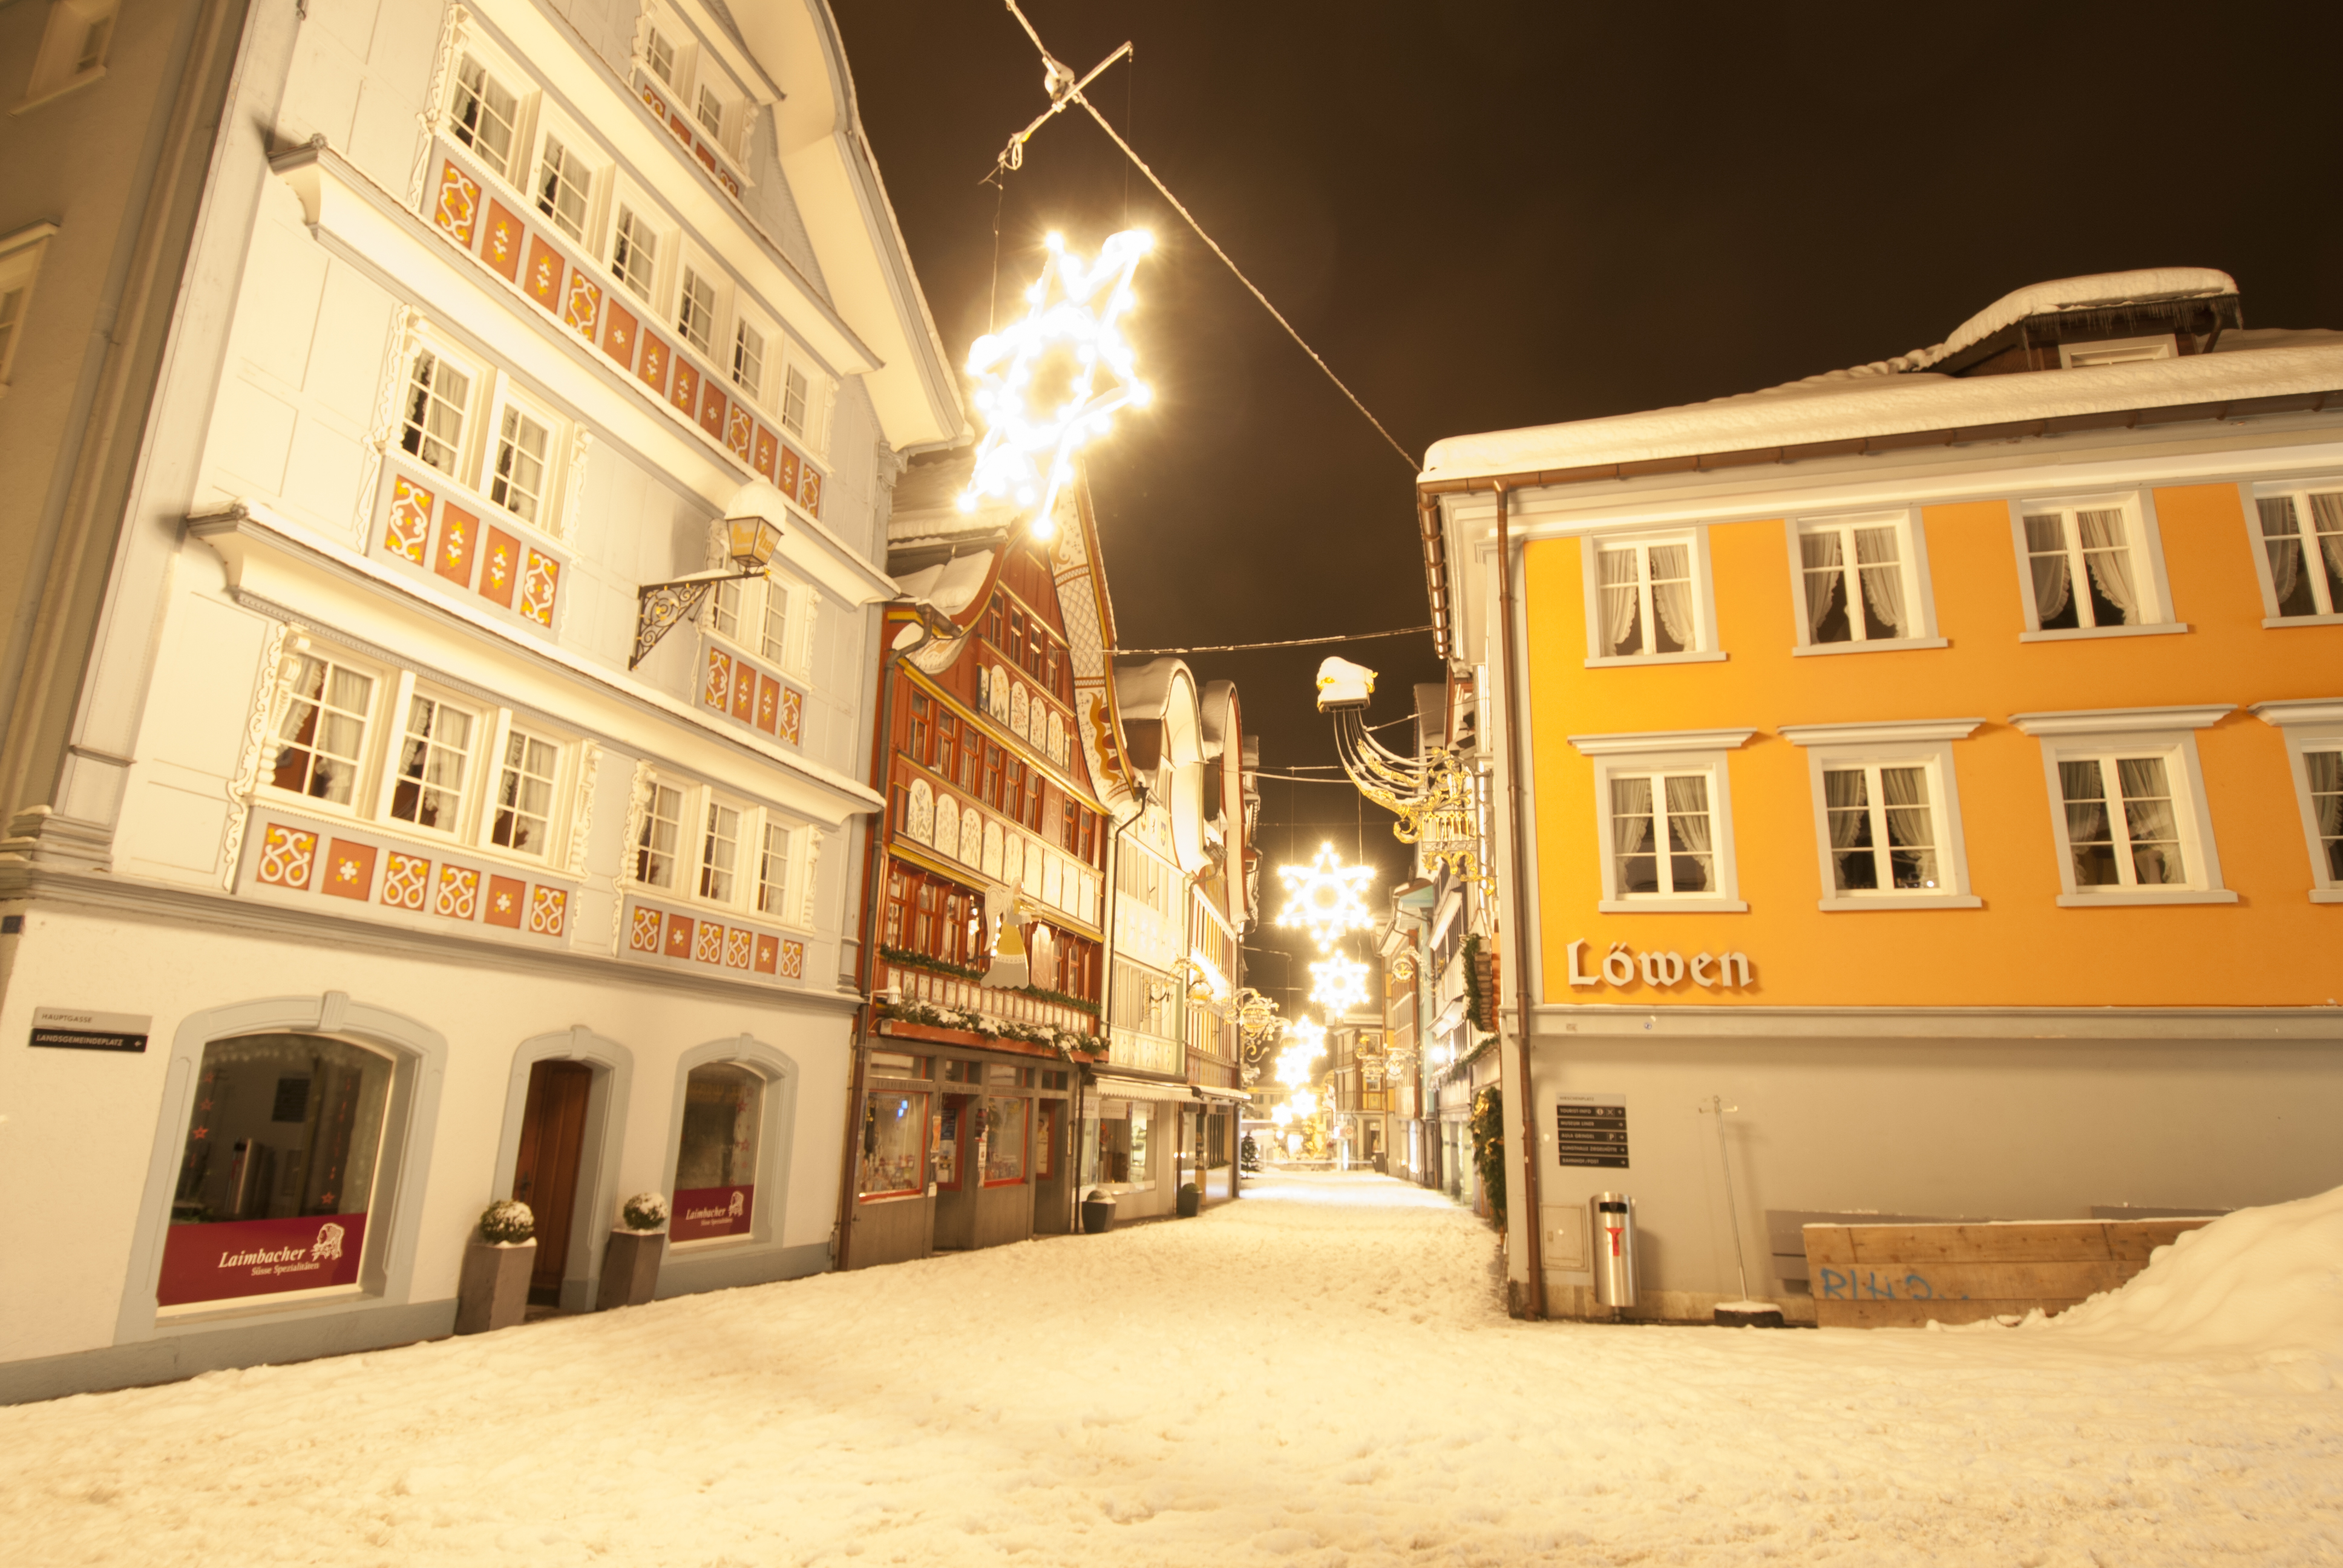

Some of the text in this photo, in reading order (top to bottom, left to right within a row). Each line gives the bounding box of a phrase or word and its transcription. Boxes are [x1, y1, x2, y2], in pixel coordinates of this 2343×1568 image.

[1566, 938, 1754, 987] Löwen
[42, 1013, 92, 1023] HAUPTGASSE
[36, 1034, 123, 1046] LANDSGEMEINDEPLATZ
[686, 1206, 726, 1220] Laimbacher
[218, 1246, 306, 1267] Laimbacher
[251, 1261, 320, 1276] Süsse Spezialitäten
